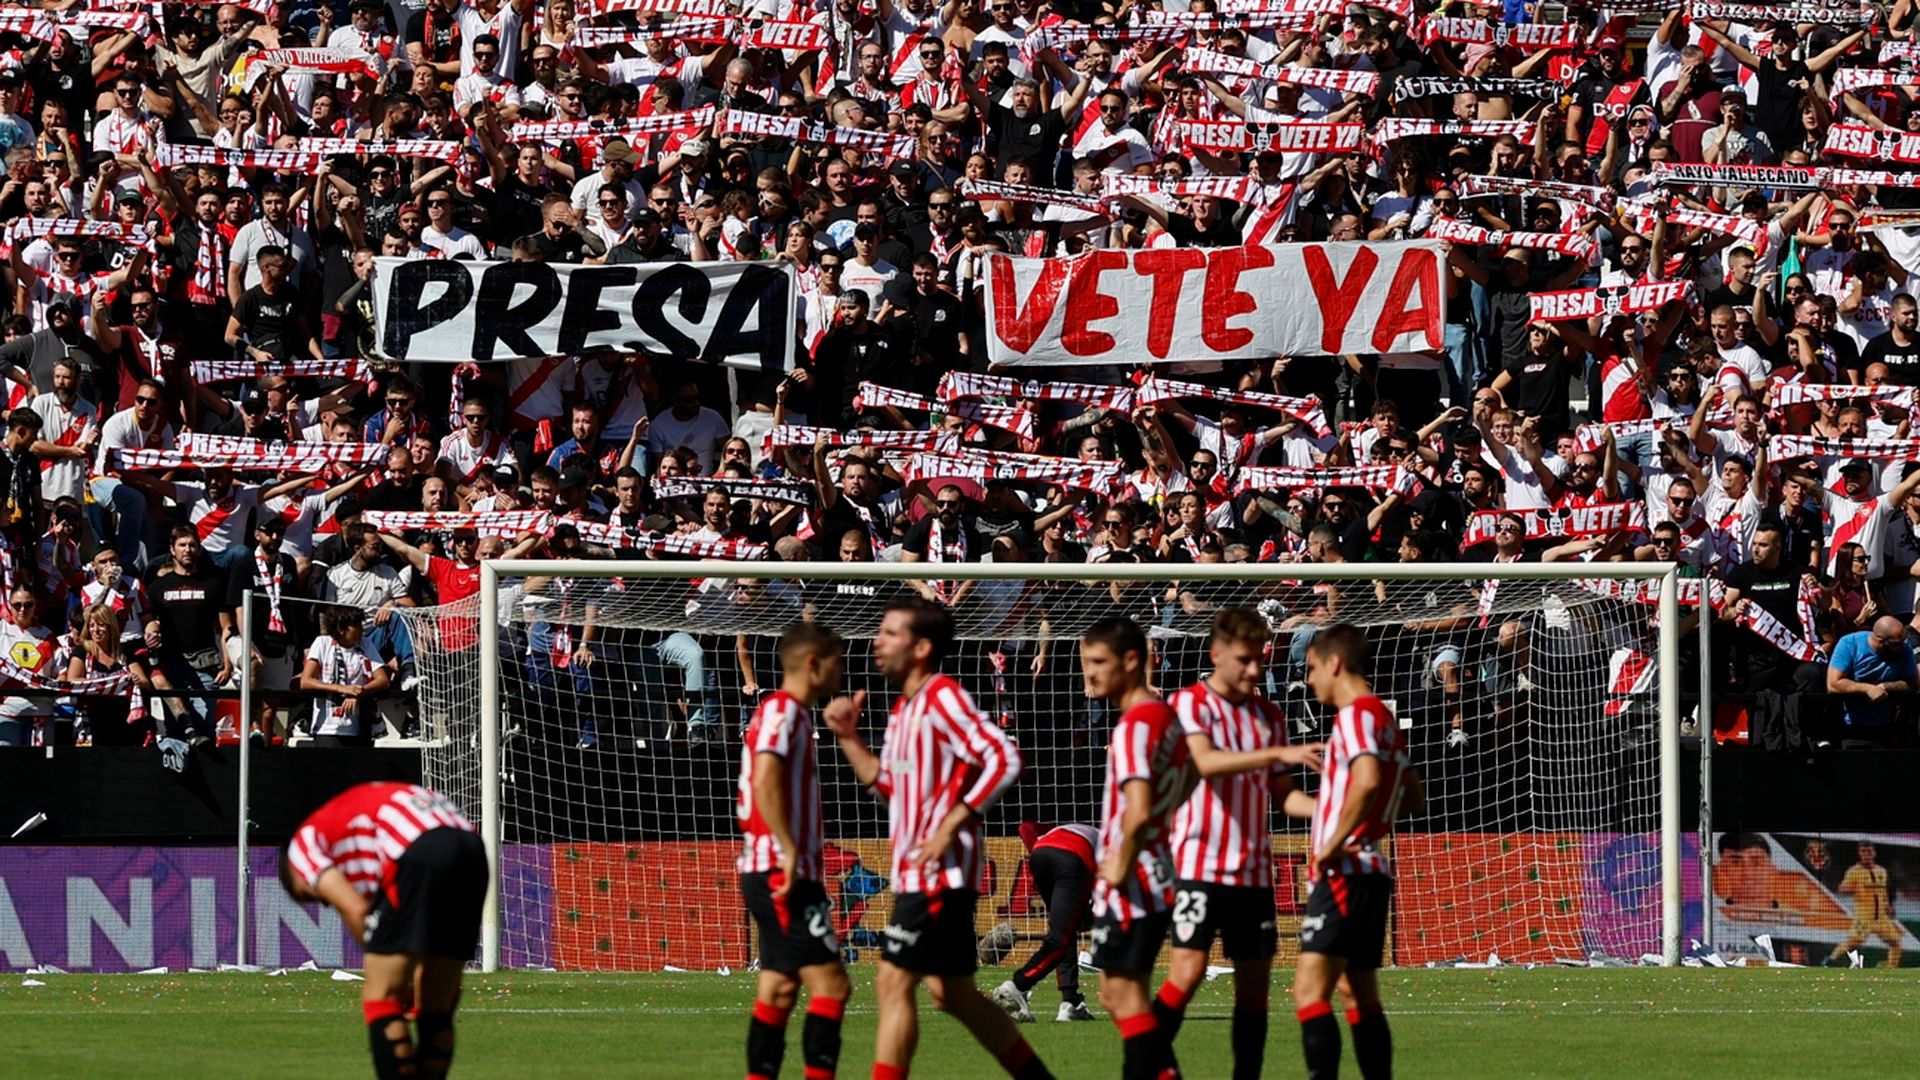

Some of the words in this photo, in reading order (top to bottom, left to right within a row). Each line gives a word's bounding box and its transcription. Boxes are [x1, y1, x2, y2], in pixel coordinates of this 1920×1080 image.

[761, 21, 814, 47] VETE
[1426, 17, 1487, 42] PRESA
[1516, 22, 1562, 45] VETE
[265, 49, 296, 65] RAYO
[1186, 47, 1256, 79] PRESA
[1287, 66, 1341, 91] VETE
[512, 121, 590, 140] PRESA
[629, 112, 688, 132] VETE
[726, 108, 801, 139] PRESA
[1180, 123, 1245, 149] PRESA
[1279, 125, 1331, 149] VETE
[1333, 124, 1361, 149] YA
[1899, 134, 1920, 160] VE
[1186, 176, 1242, 198] VETE
[1672, 165, 1714, 181] RAYO
[1716, 167, 1810, 185] VALLECANO
[1509, 233, 1561, 248] VETE
[991, 246, 1275, 359] VETE
[1302, 244, 1443, 354] YA
[1530, 292, 1596, 318] PRESA
[1628, 283, 1678, 310] VETE
[382, 259, 790, 372] PRESA
[1049, 383, 1106, 406] VETE
[119, 449, 183, 469] SOS
[293, 441, 359, 462] VETE
[909, 453, 986, 482] PRESA
[1468, 511, 1541, 543] PRA
[1572, 505, 1626, 534] VETE
[1648, 578, 1701, 601] VTE
[1172, 891, 1207, 925] 23
[0, 877, 345, 969] NIN
